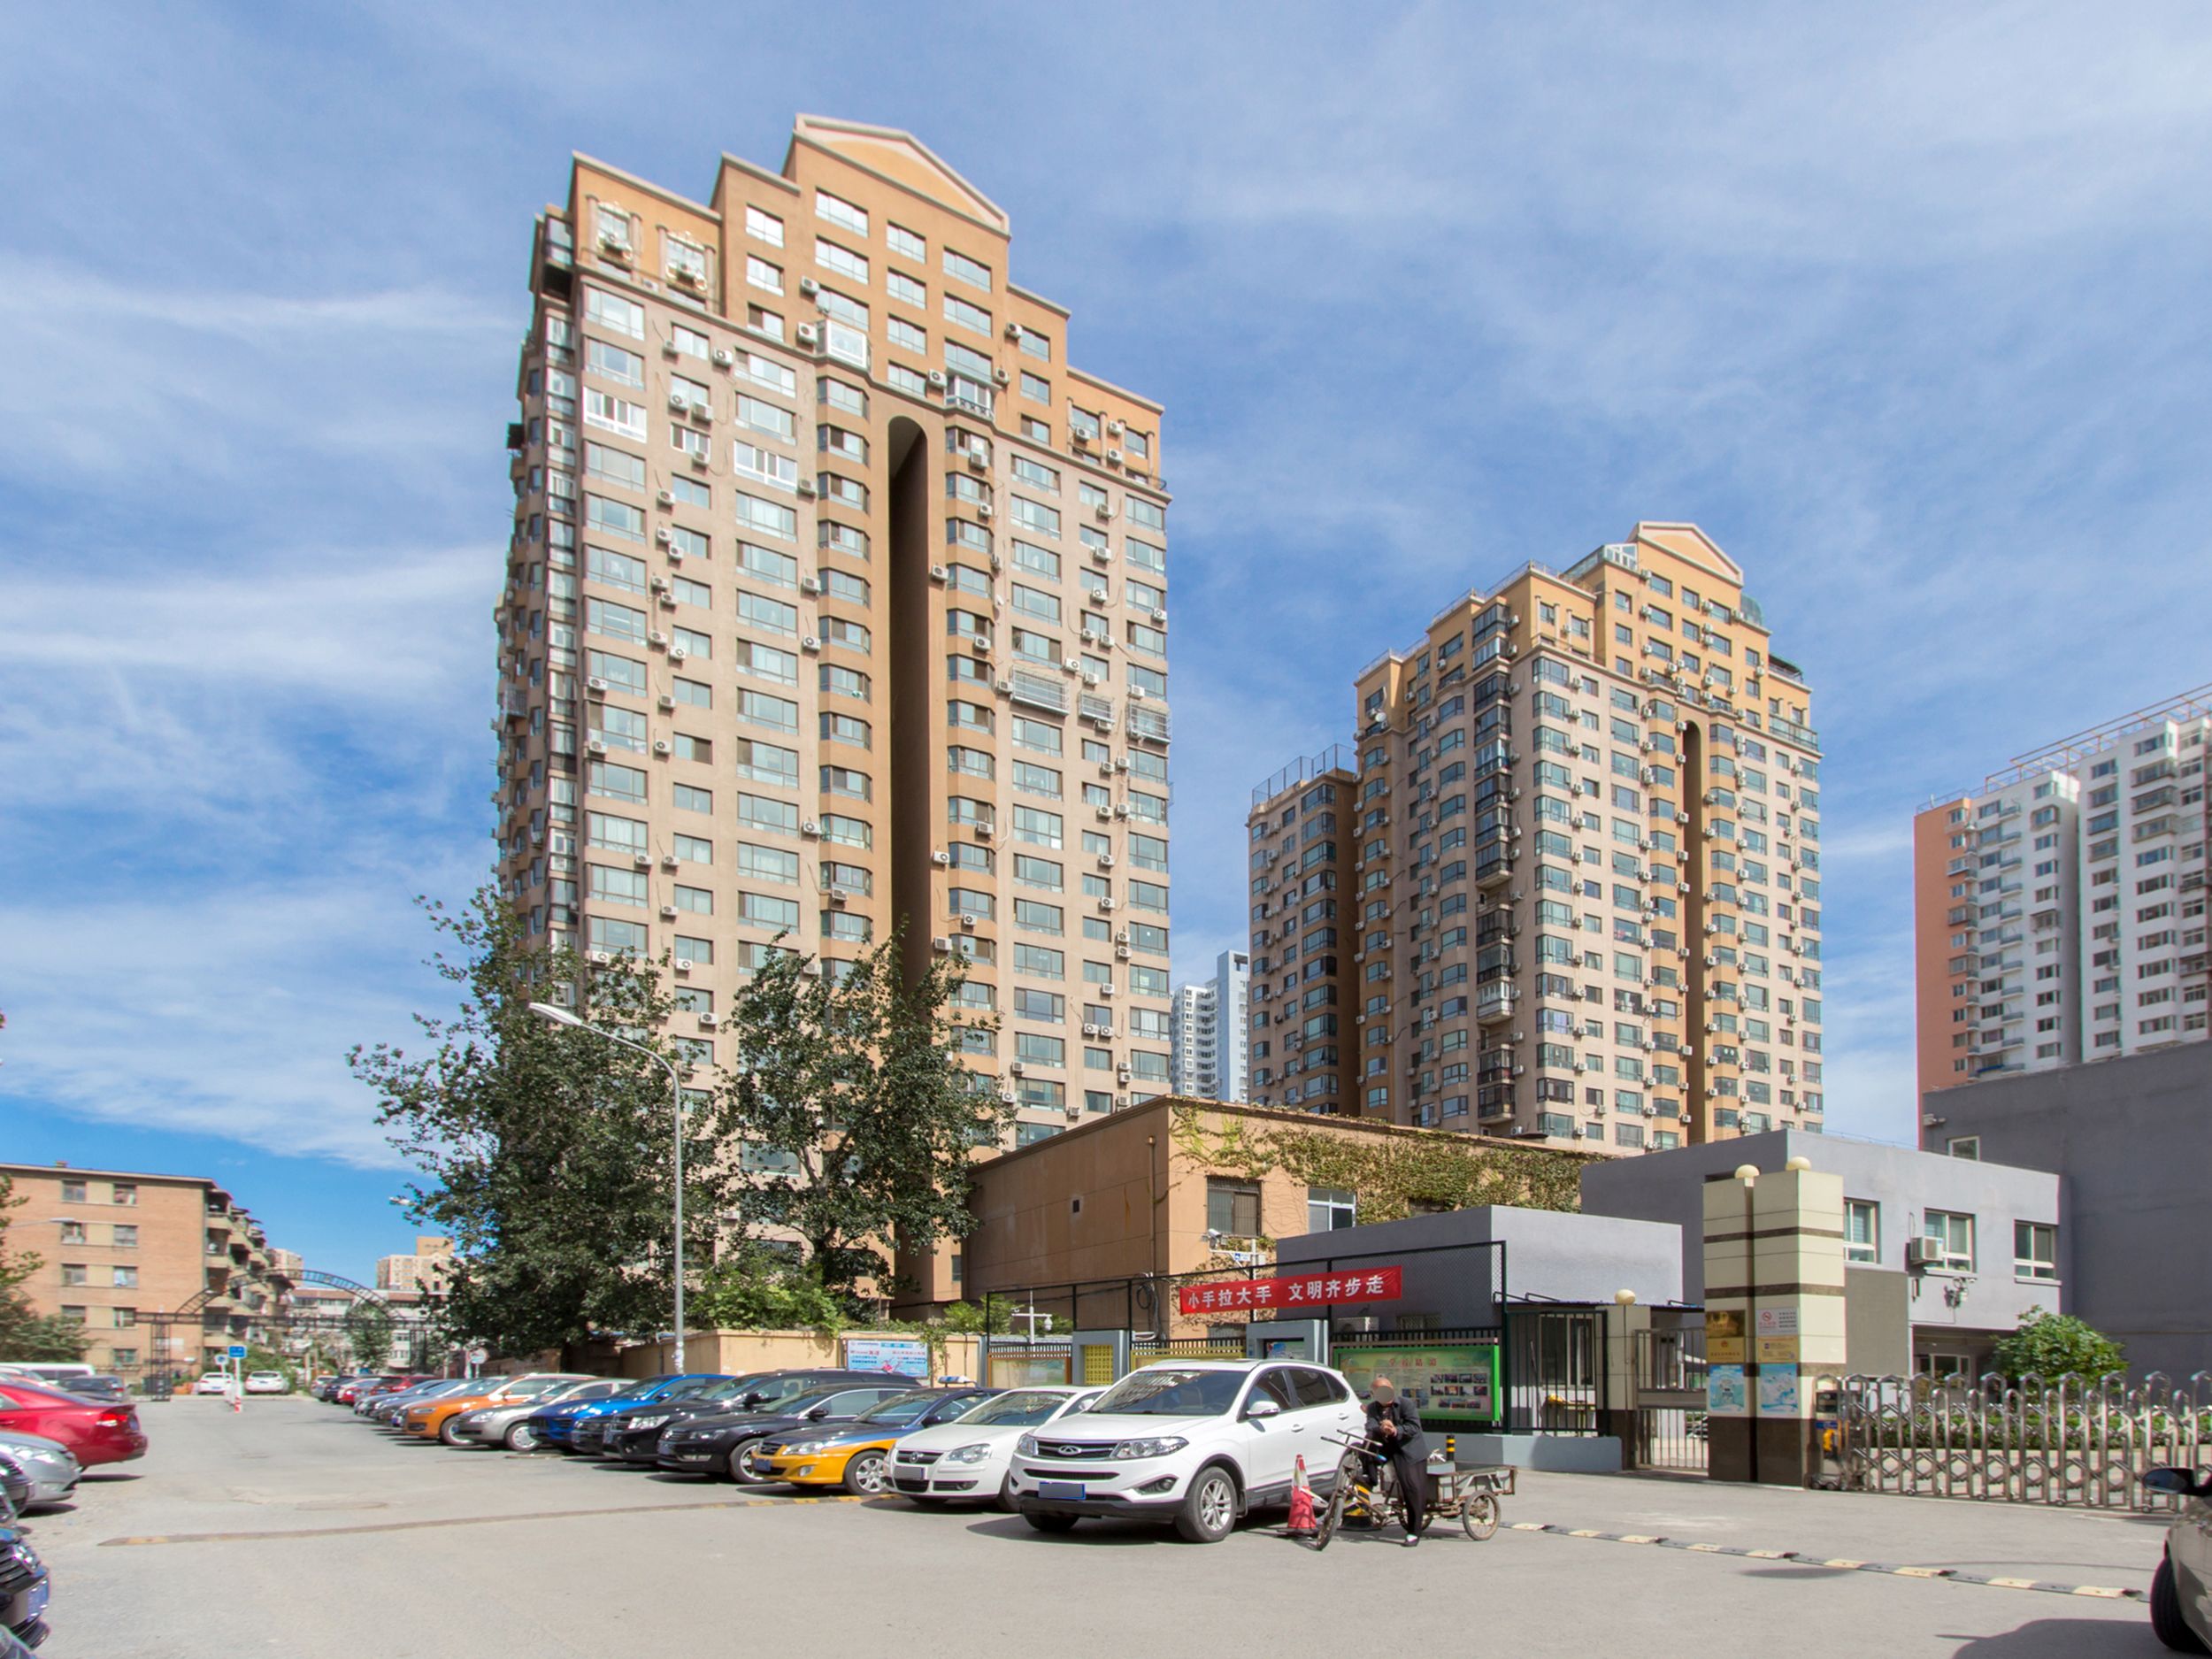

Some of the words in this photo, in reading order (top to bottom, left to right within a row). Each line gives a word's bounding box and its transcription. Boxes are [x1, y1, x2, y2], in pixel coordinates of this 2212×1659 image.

[1188, 1286, 1272, 1309] 小手拉大手
[1288, 1275, 1384, 1301] 文明齐步走
